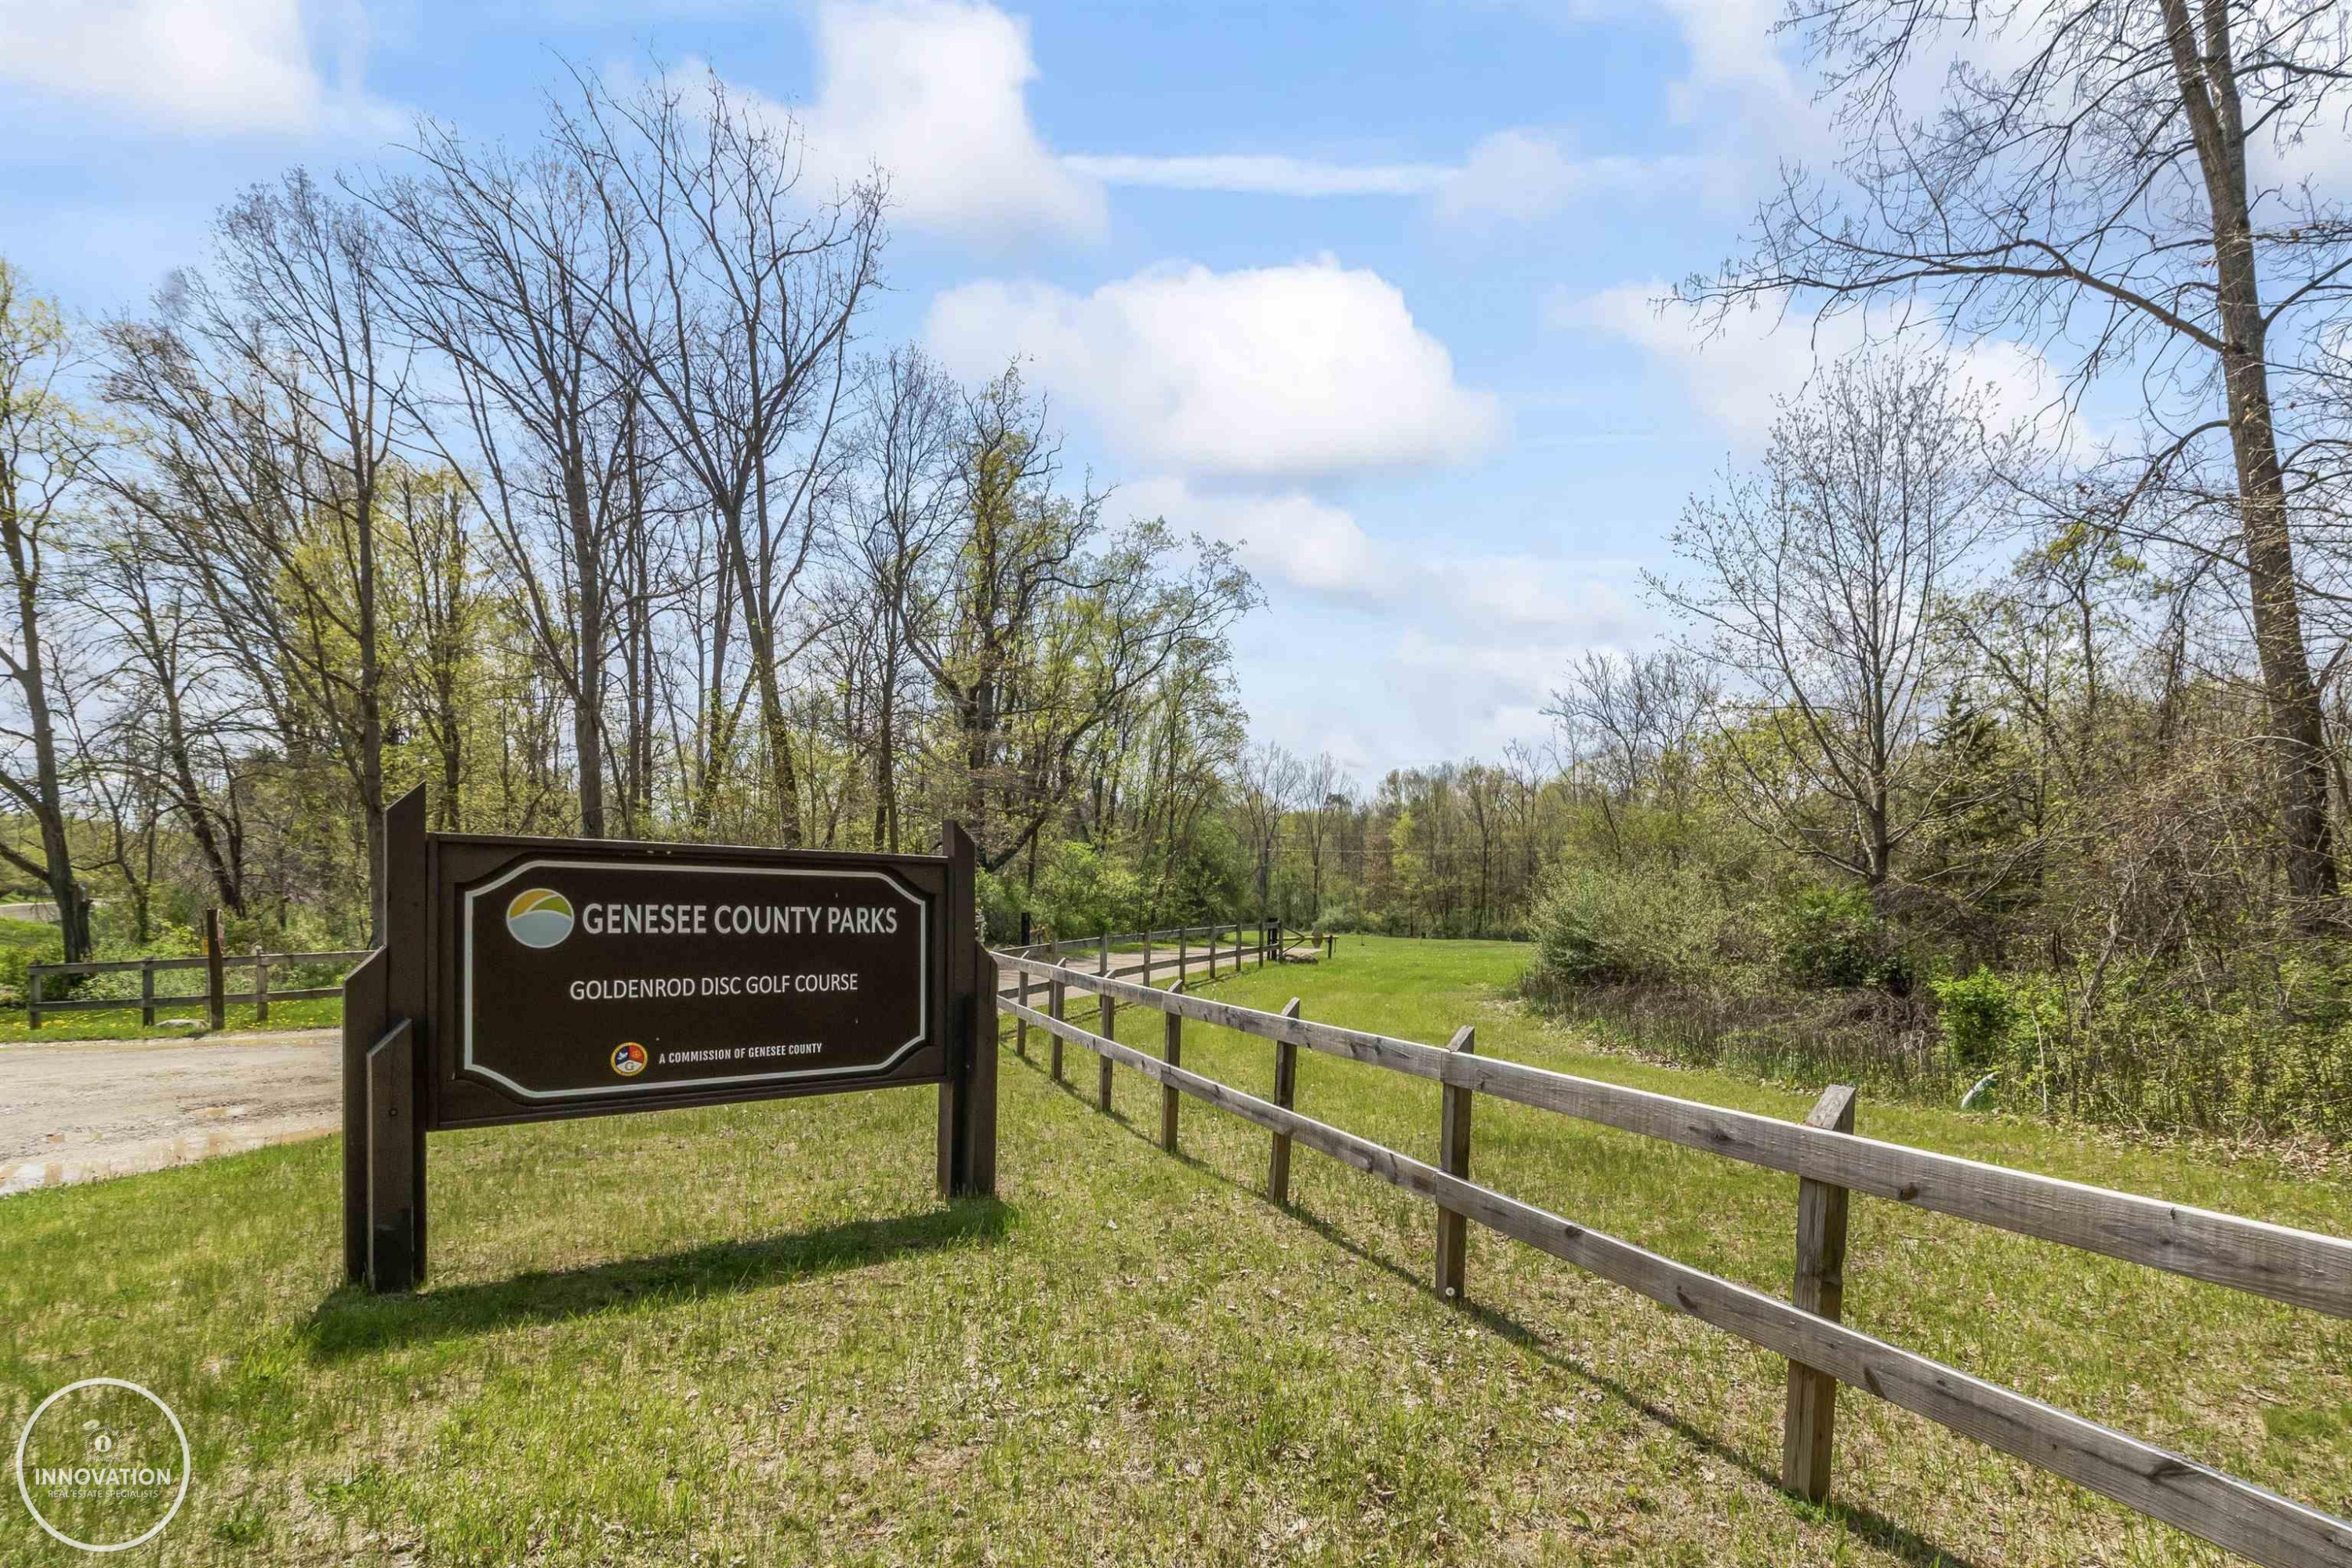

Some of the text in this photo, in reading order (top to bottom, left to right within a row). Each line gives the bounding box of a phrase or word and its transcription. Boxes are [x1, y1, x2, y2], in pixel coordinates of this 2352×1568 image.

[583, 903, 898, 935] GENESEE COUNTY PARKS
[569, 973, 858, 1000] GOLDENROD DISC GOLF COURSE
[659, 1043, 822, 1065] A COMMISSION OF GENESEE COUNTY
